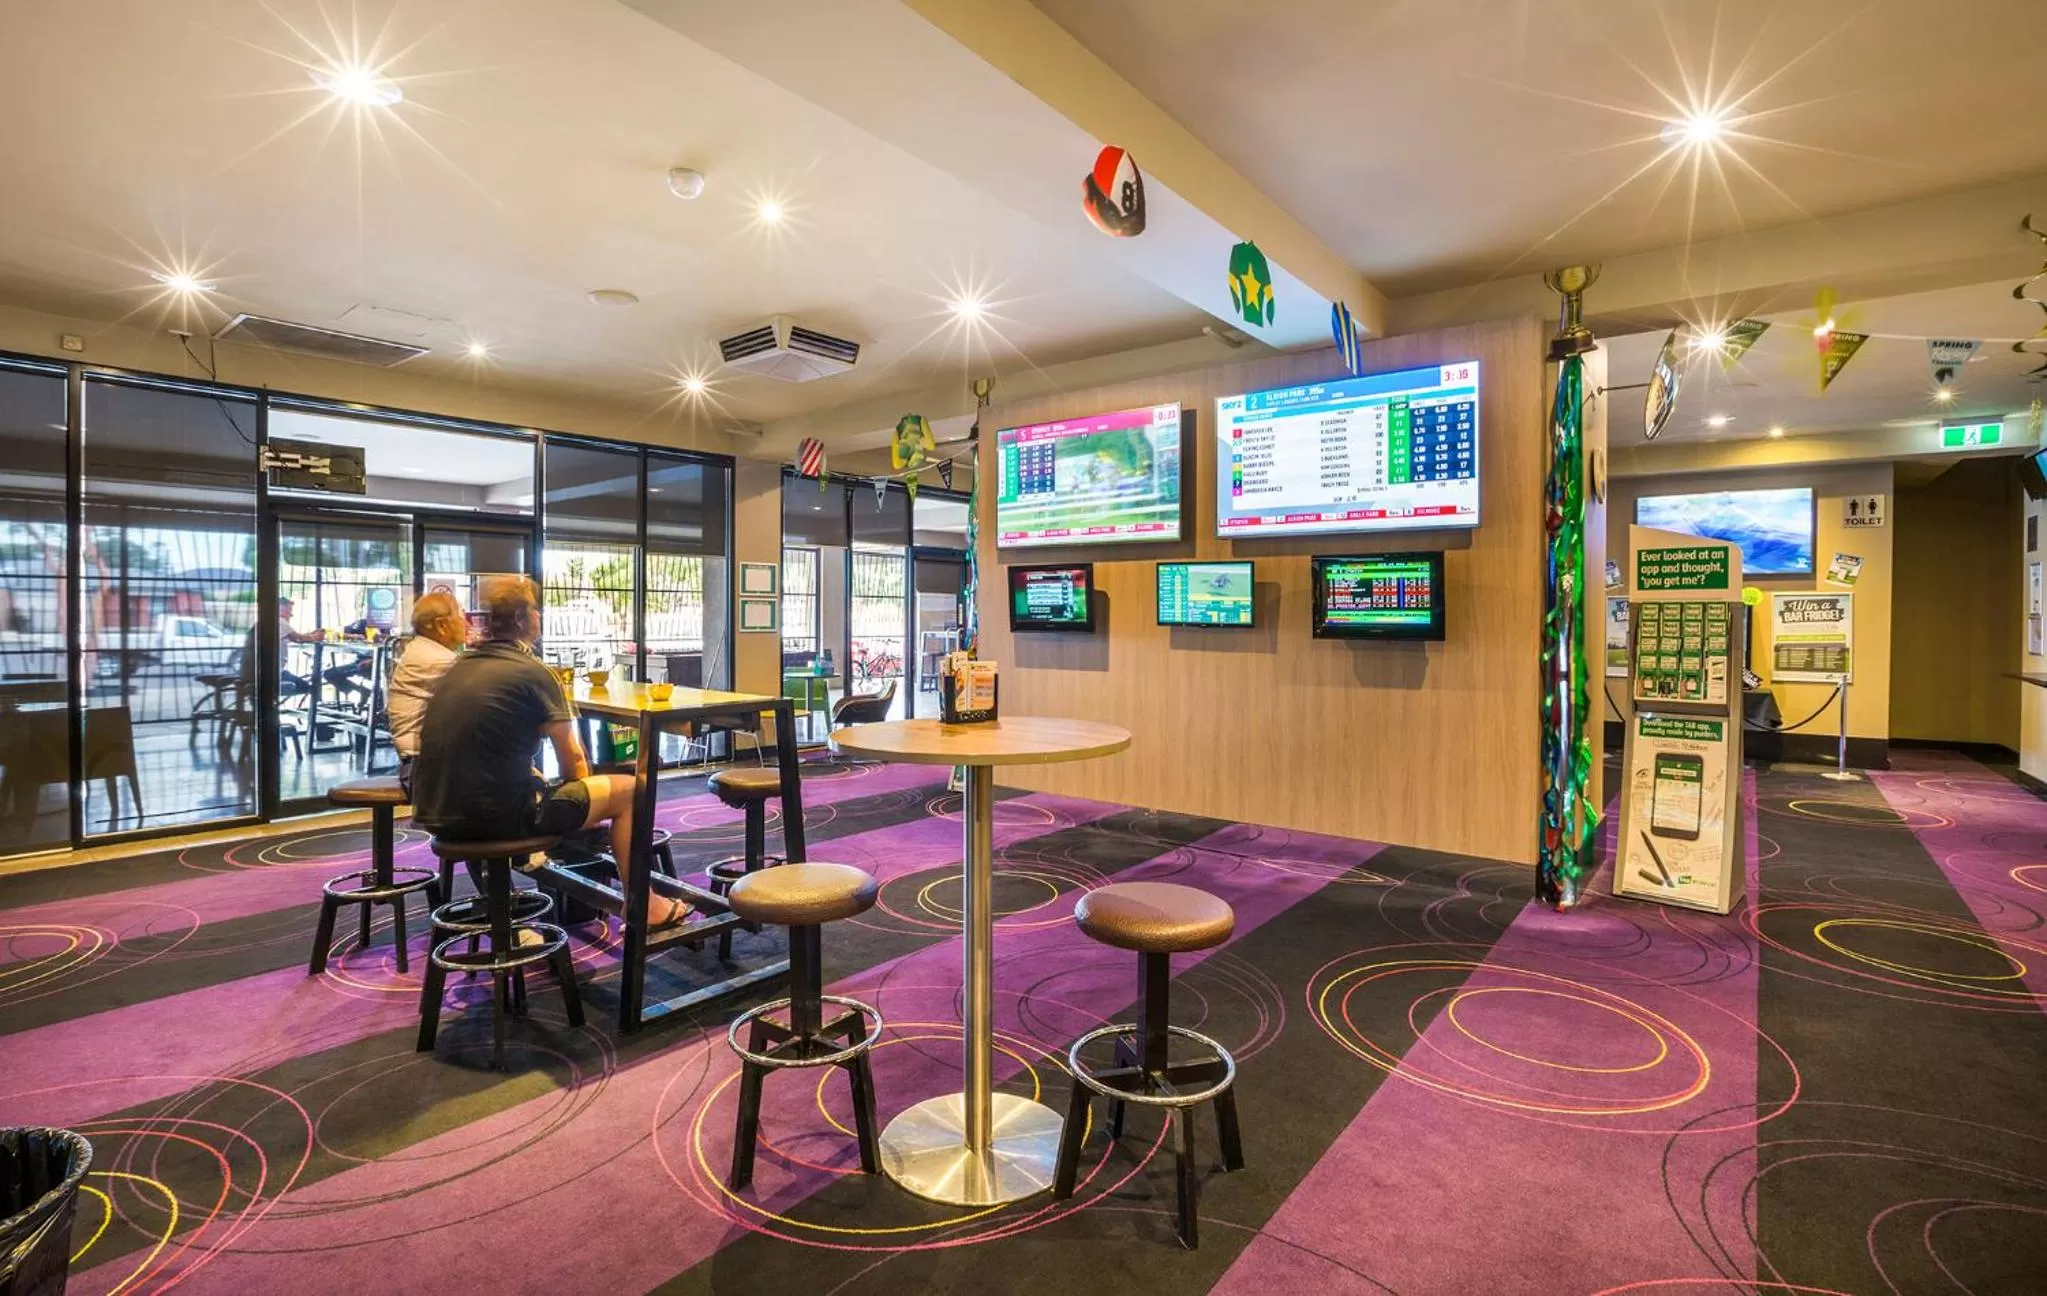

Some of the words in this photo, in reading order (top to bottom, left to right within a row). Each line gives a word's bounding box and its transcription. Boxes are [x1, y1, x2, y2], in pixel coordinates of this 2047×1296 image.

[1932, 340, 1973, 348] SPRING
[1845, 517, 1882, 526] TOILET
[1641, 552, 1661, 561] Ever
[1663, 550, 1696, 560] looked
[1698, 550, 1709, 560] at
[1711, 550, 1724, 559] an
[1641, 565, 1659, 576] app
[1661, 563, 1680, 573] and
[1664, 576, 1680, 588] get
[1789, 600, 1819, 611] Win
[1784, 611, 1803, 621] BAR
[1804, 609, 1839, 621] FRIDGE!
